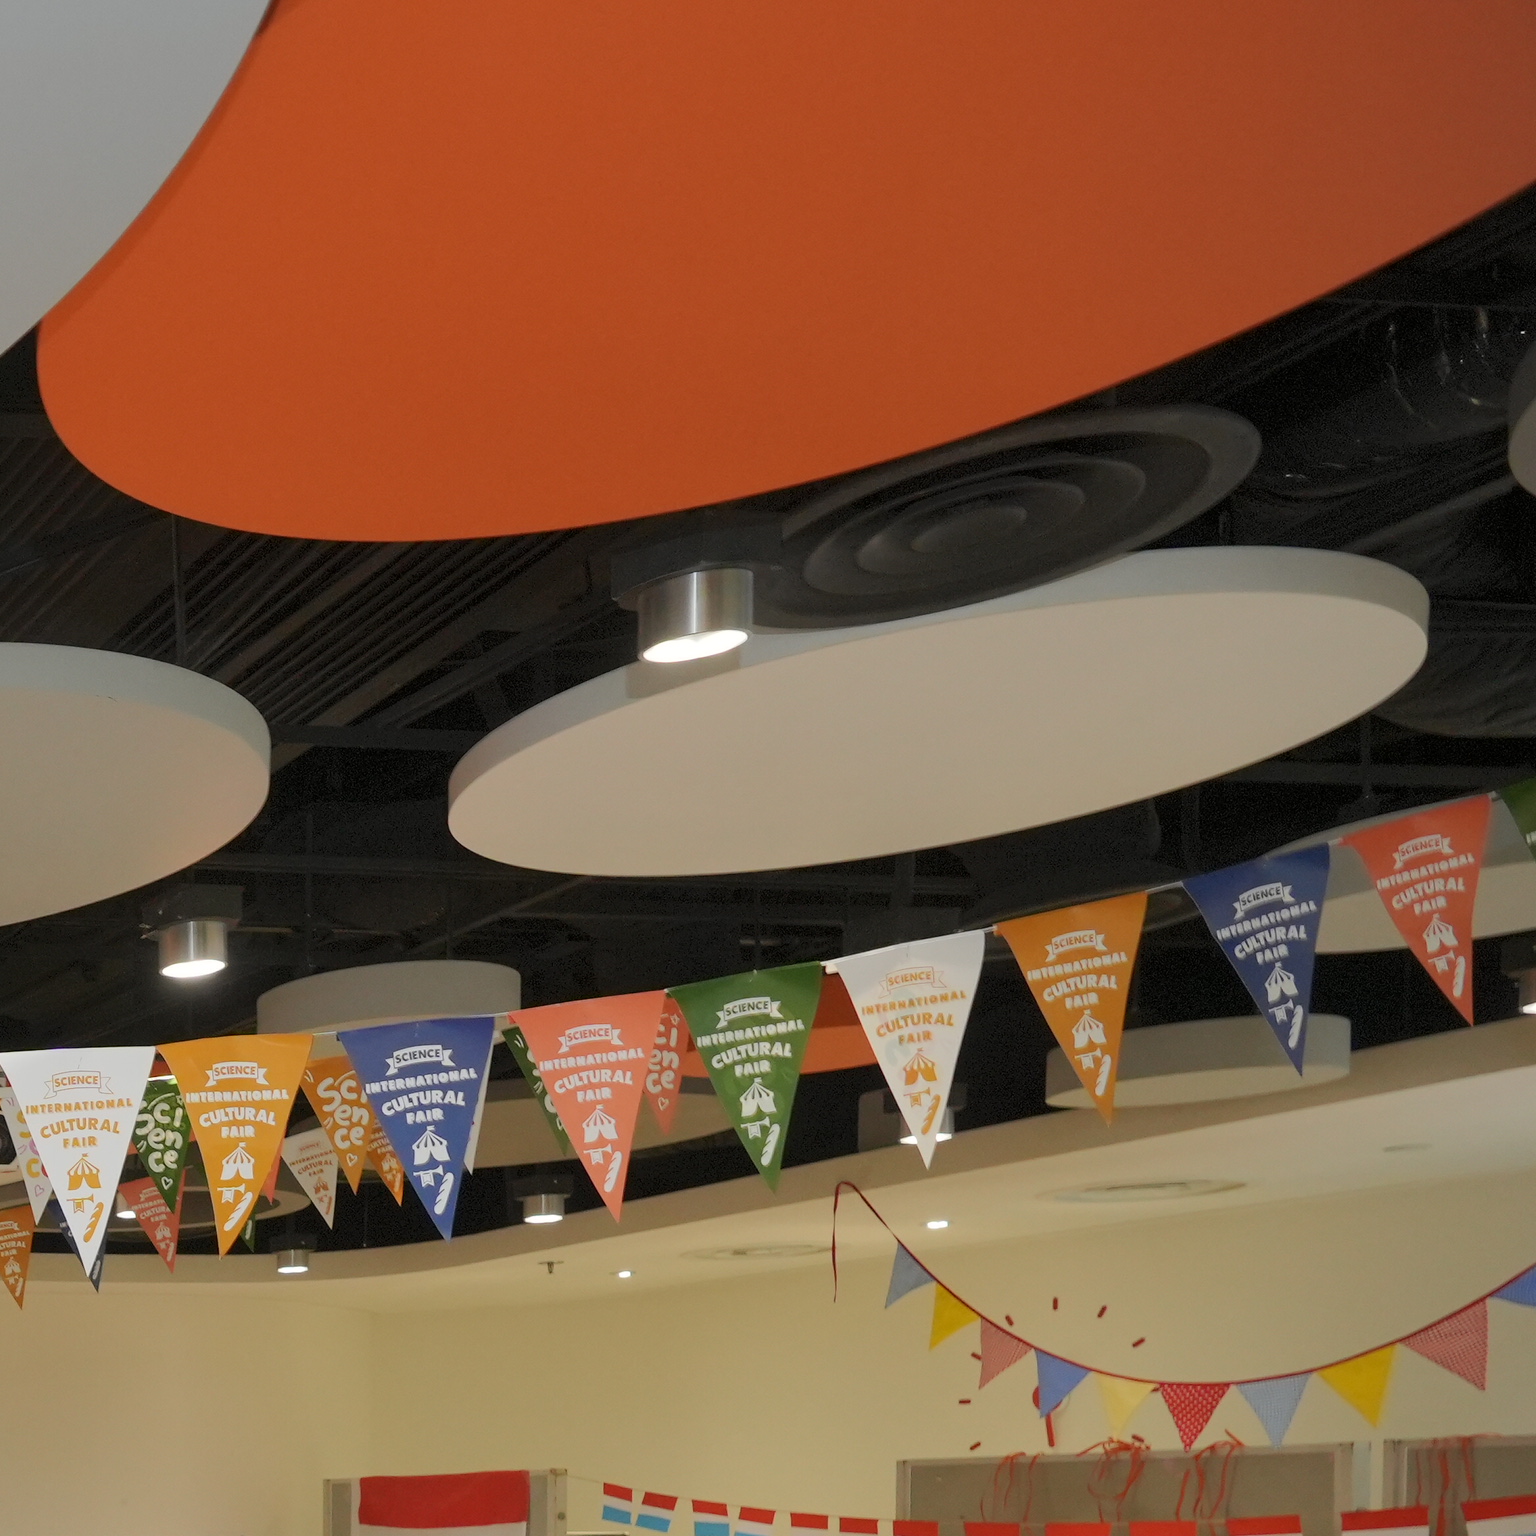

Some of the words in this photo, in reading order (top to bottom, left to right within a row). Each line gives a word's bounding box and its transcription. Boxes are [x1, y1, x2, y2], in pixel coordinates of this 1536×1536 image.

[1375, 852, 1474, 890] INTERNATIONAL
[1391, 877, 1465, 908] CULTURAL
[1414, 895, 1448, 915] FAIR
[1216, 899, 1316, 940] INTERNATIONAL
[1053, 933, 1094, 950] SCIENCE
[1233, 925, 1307, 958] CULTURAL
[1255, 943, 1290, 964] FAIR
[1027, 950, 1128, 981] INTERNATIONAL
[1043, 975, 1117, 1001] CULTURAL
[725, 1000, 769, 1016] SCIENCE
[860, 989, 965, 1017] INTERNATIONAL
[1065, 992, 1099, 1010] FAIR
[566, 1027, 609, 1042] SCIENCE
[696, 1018, 804, 1048] INTERNATIONAL
[875, 1012, 953, 1037] CULTURAL
[898, 1029, 934, 1046] FAIR
[394, 1048, 440, 1063] SCIENCE
[538, 1047, 644, 1072] INTERNATIONAL
[711, 1042, 792, 1068] CULTURAL
[214, 1065, 256, 1076] SCIENCE
[735, 1059, 771, 1077] FAIR
[54, 1075, 98, 1088] SCIENCE
[365, 1067, 477, 1094] INTERNATIONAL
[554, 1069, 633, 1093] CULTURAL
[185, 1088, 288, 1103] INTERNATIONAL
[382, 1090, 465, 1115] CULTURAL
[577, 1086, 613, 1103] FAIR
[25, 1097, 132, 1116] INTERNATIONAL
[199, 1106, 276, 1127] CULTURAL
[406, 1108, 444, 1125] FAIR
[40, 1117, 120, 1139] CULTURAL
[221, 1125, 256, 1138] FAIR
[63, 1135, 99, 1150] FAIR
